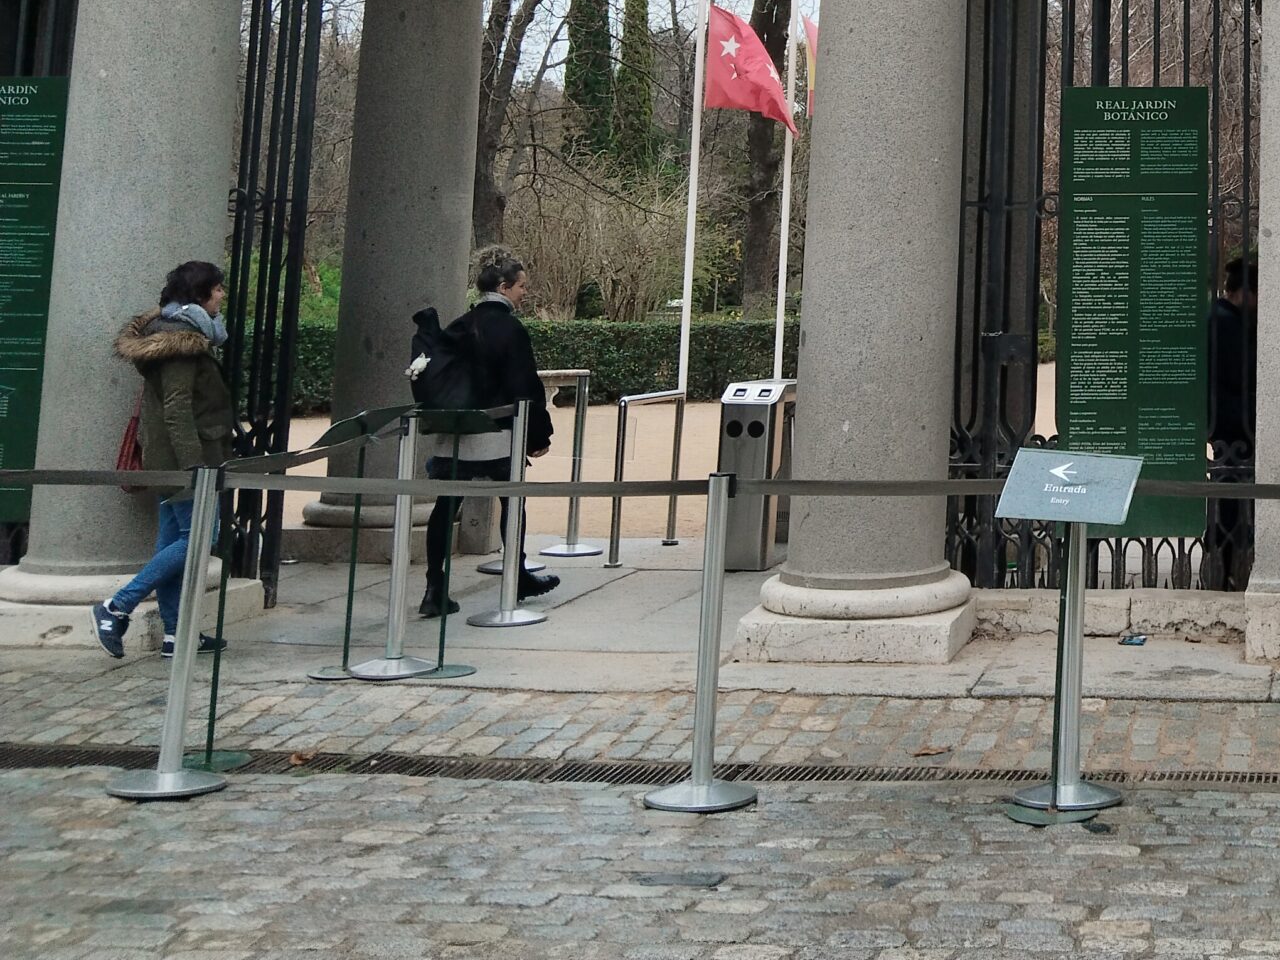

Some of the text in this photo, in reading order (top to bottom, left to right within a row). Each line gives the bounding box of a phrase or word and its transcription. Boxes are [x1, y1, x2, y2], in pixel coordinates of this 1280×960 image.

[1096, 100, 1130, 110] REAL
[1043, 483, 1087, 494] Entrada
[1050, 496, 1070, 505] Entry
